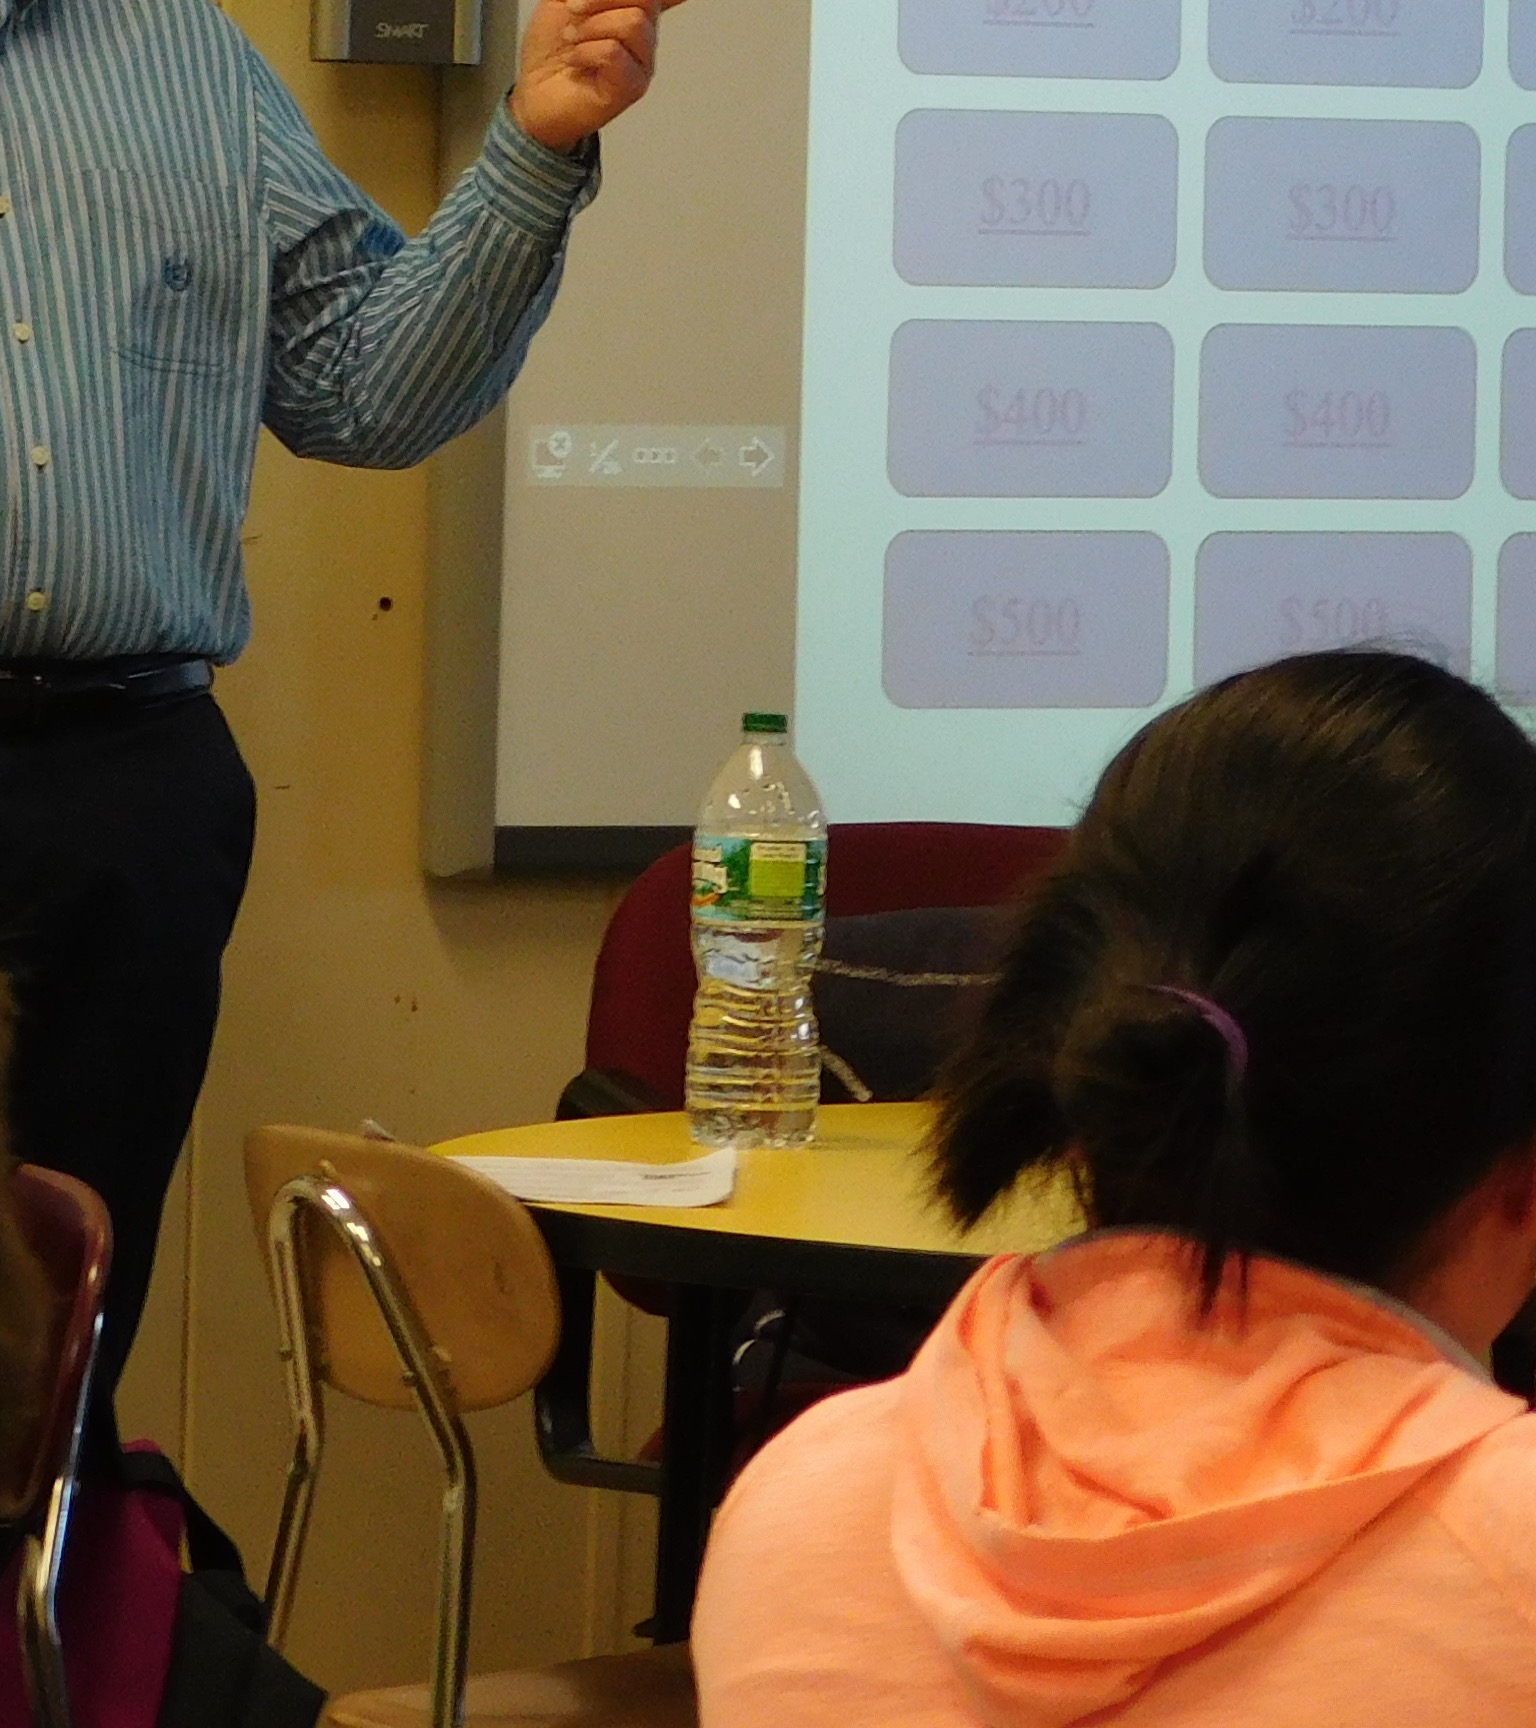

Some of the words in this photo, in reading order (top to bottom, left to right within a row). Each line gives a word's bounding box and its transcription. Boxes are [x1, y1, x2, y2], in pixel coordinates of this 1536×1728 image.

[375, 22, 430, 38] SMART
[978, 176, 1092, 236] $300
[1286, 183, 1397, 242] $300
[973, 386, 1088, 446] $400
[1282, 390, 1392, 448] $400
[967, 594, 1082, 657] $500
